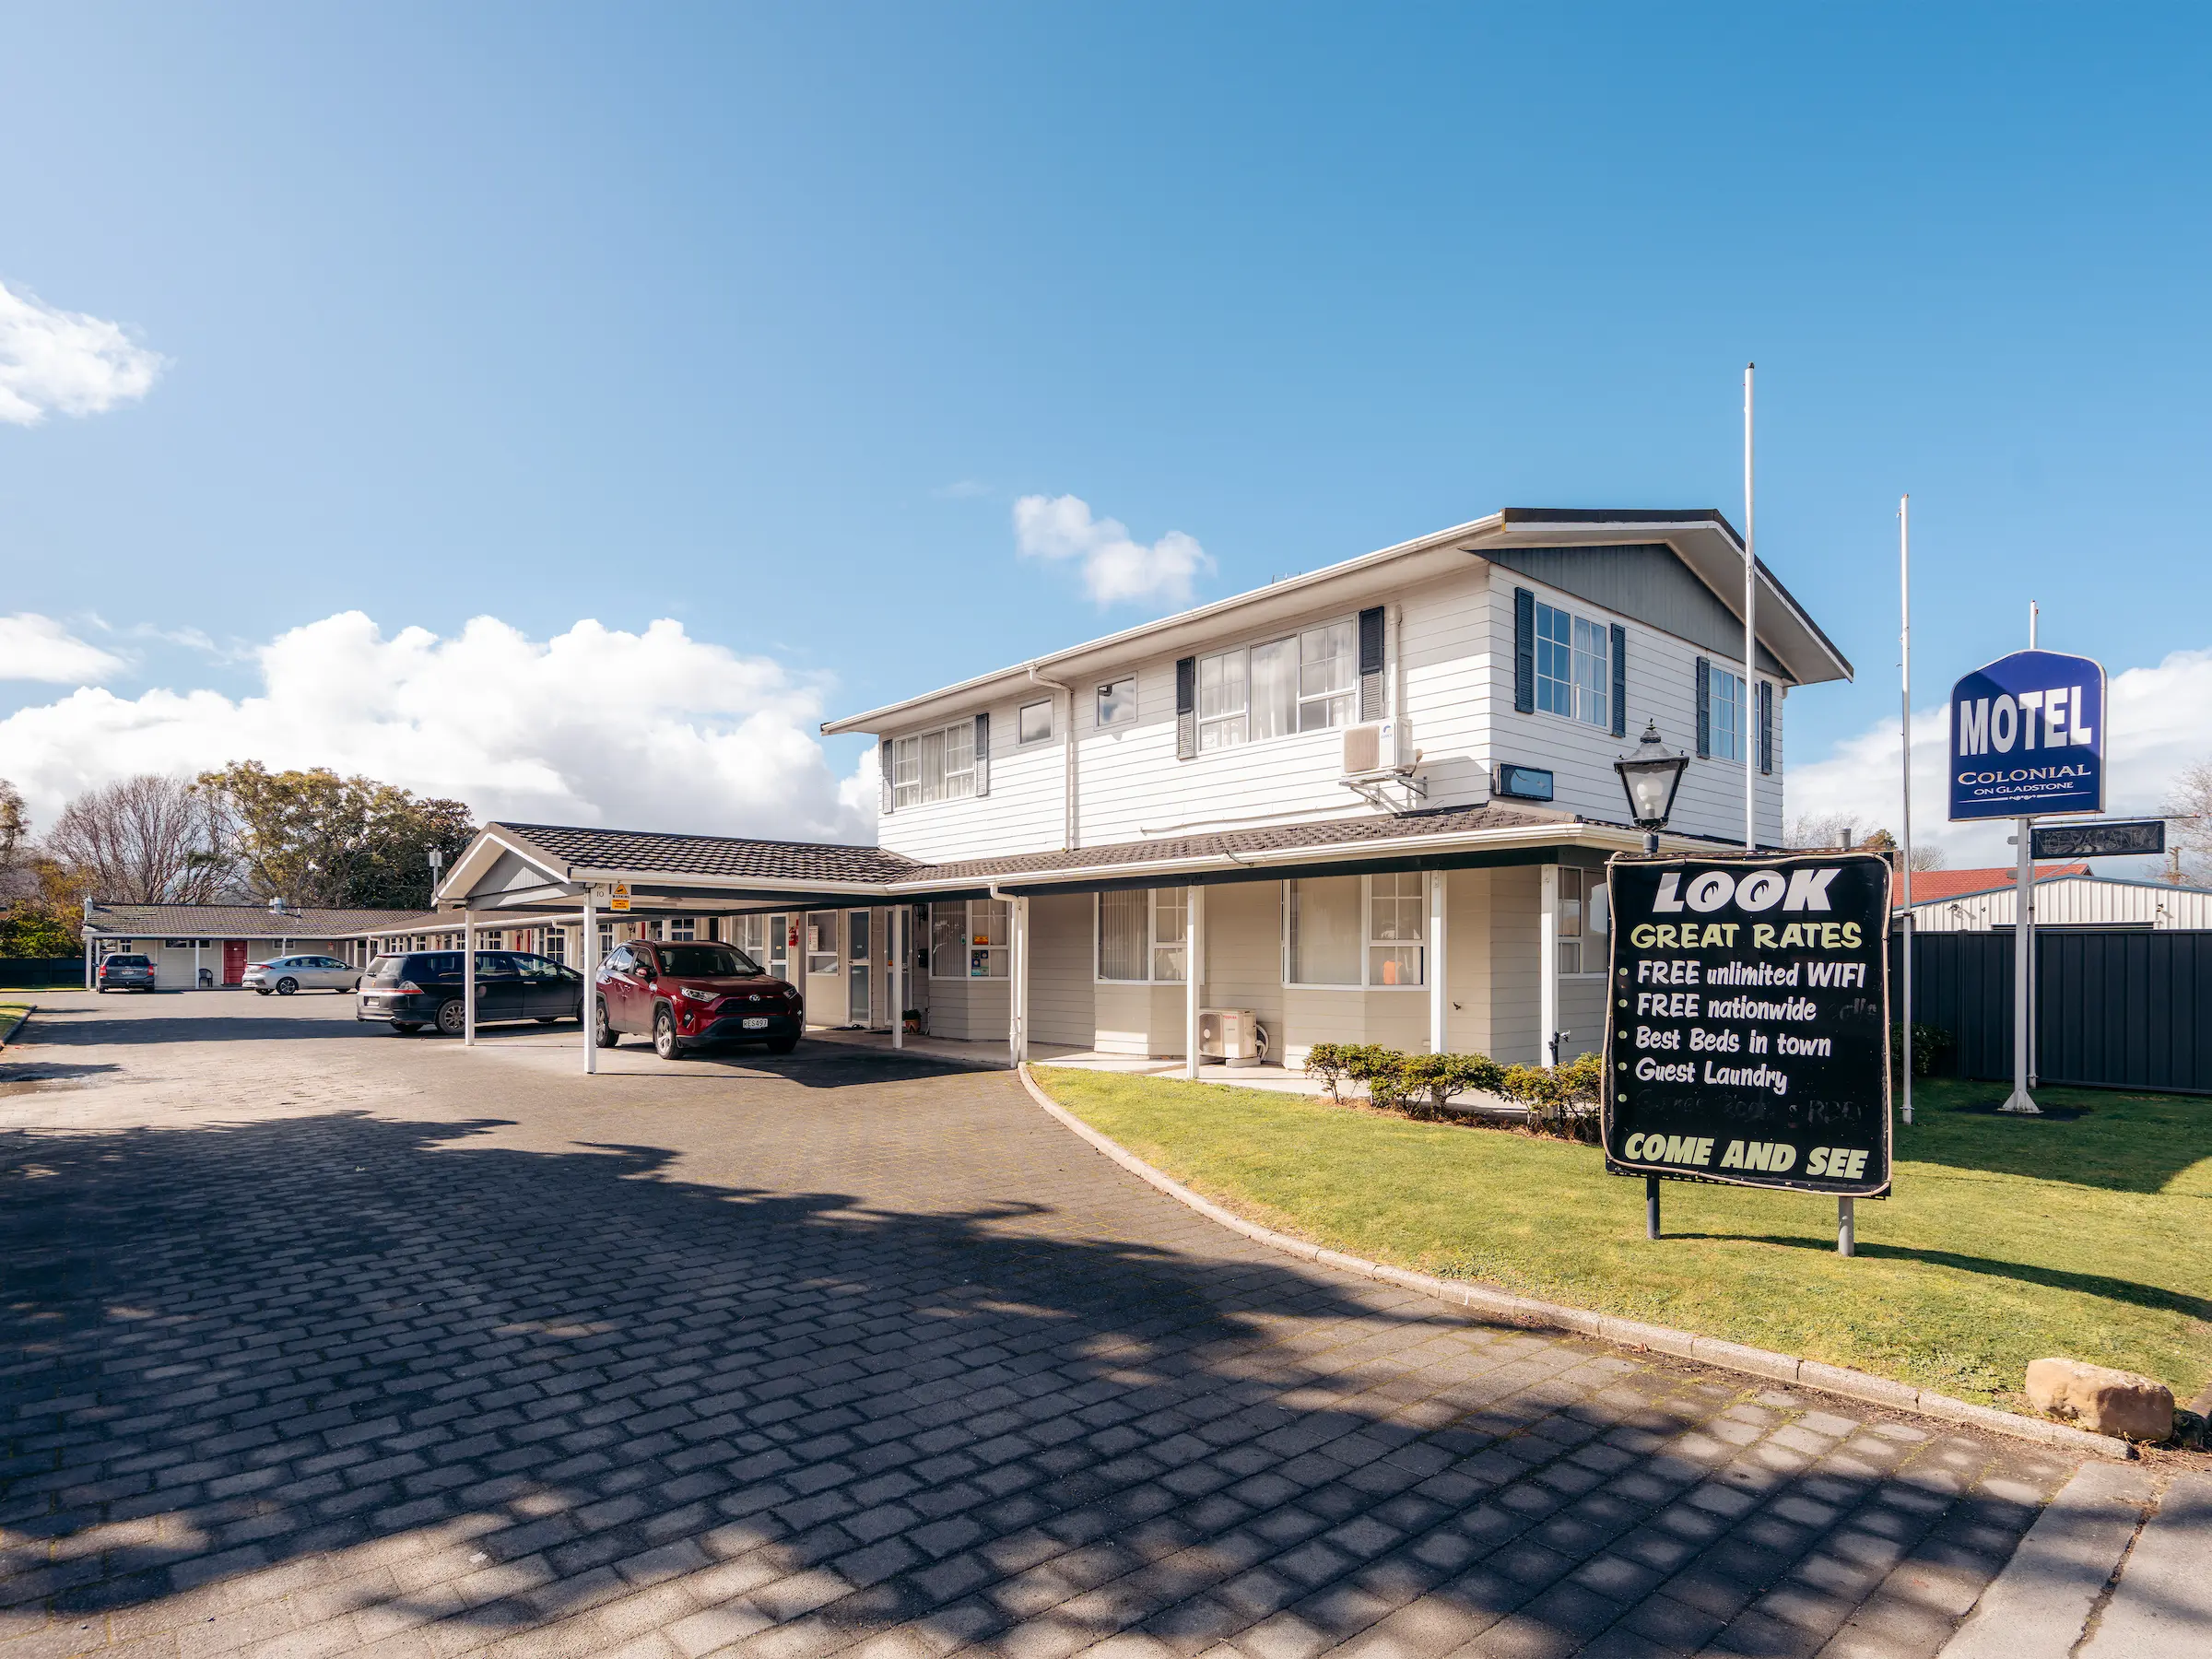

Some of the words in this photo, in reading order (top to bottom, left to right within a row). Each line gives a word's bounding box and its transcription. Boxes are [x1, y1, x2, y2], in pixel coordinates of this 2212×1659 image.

[1959, 686, 2092, 756] MOTEL
[1958, 764, 2091, 785] COLONIAL
[1974, 787, 1994, 795] ON
[1996, 782, 2074, 794] GLADSTONE
[2035, 831, 2061, 855] NO
[2070, 825, 2160, 850] VACANCY
[1653, 869, 1841, 912] LOOK
[1630, 924, 1740, 948] GREAT
[1753, 922, 1863, 949] RATES
[1637, 960, 1700, 985] FREE
[1707, 961, 1800, 987] unlimited
[1807, 962, 1866, 988] WIFI
[1637, 993, 1700, 1018] FREE
[1708, 995, 1817, 1021] nationwide
[1636, 1026, 1680, 1051] Best
[1689, 1028, 1740, 1053] Beds
[1748, 1030, 1769, 1054] in
[1777, 1032, 1831, 1057] town
[1635, 1057, 1696, 1083] Guest
[1704, 1061, 1788, 1095] Laundry
[1624, 1133, 1715, 1166] COME
[1720, 1140, 1796, 1171] AND
[1806, 1147, 1869, 1180] SEE
